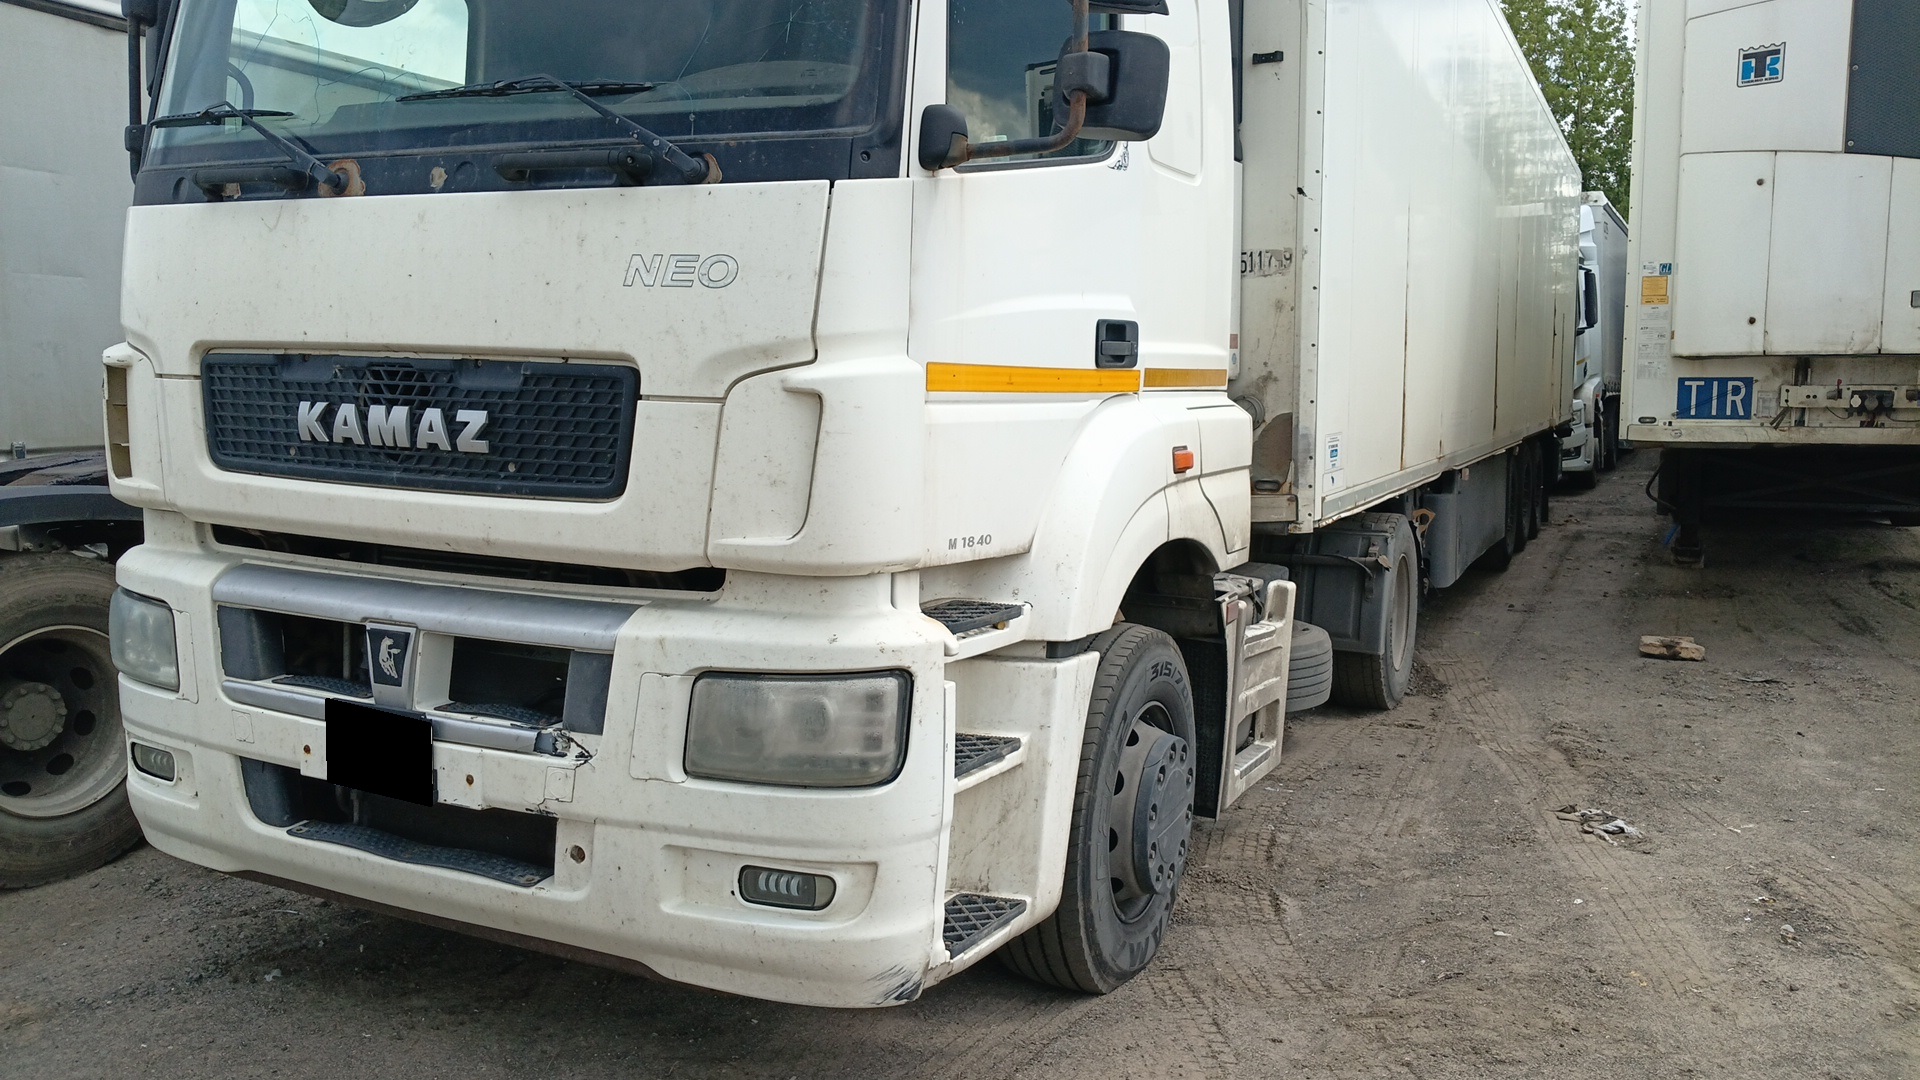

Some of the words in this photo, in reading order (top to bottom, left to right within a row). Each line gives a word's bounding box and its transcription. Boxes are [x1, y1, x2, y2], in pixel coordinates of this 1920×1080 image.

[622, 253, 739, 289] NEO
[1684, 380, 1746, 416] TIR
[298, 401, 490, 453] KAMAZ
[948, 537, 958, 550] M
[961, 534, 992, 549] 1840
